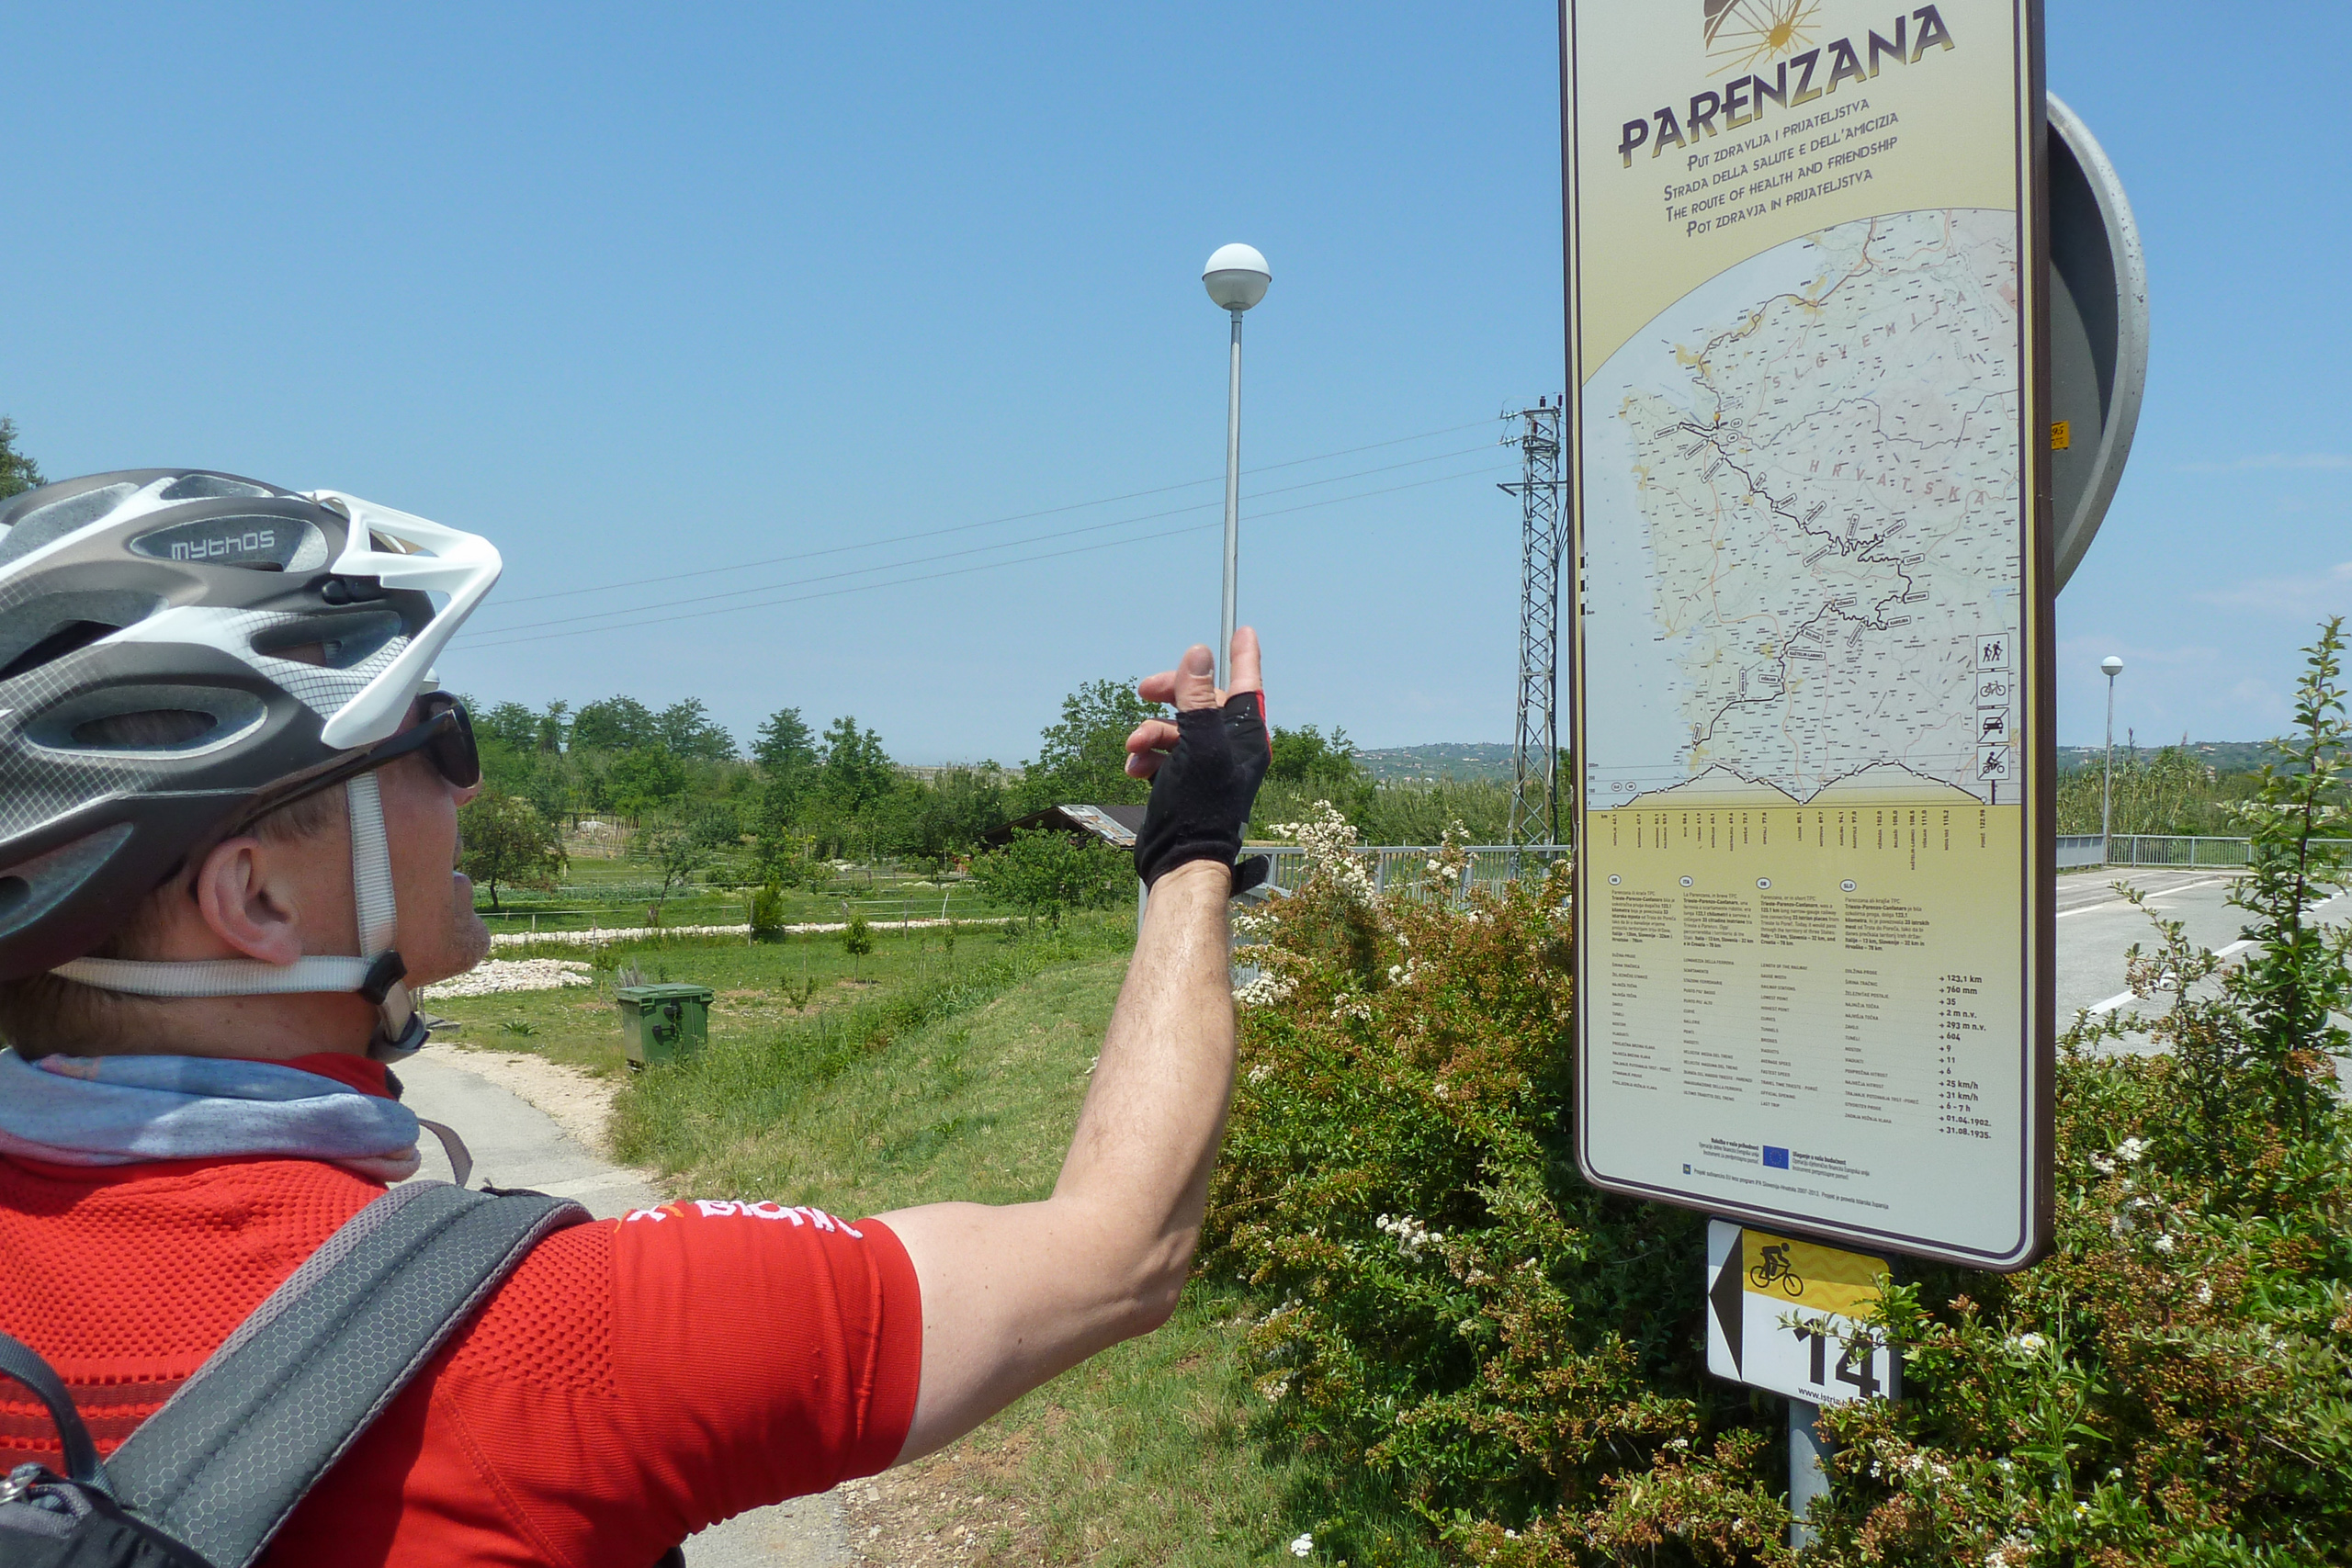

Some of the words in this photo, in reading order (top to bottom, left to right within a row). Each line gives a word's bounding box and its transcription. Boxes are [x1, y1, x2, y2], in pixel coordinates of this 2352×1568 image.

[1618, 5, 1955, 169] PARENZANA
[1970, 975, 1982, 983] km
[1947, 1032, 1961, 1041] 604
[1958, 1080, 1979, 1089] km/h
[1958, 1092, 1979, 1101] km/h
[1947, 1114, 1992, 1126] 01.04.1902.
[1947, 1126, 1992, 1139] 31.08.1935.
[1792, 1317, 1881, 1397] 14
